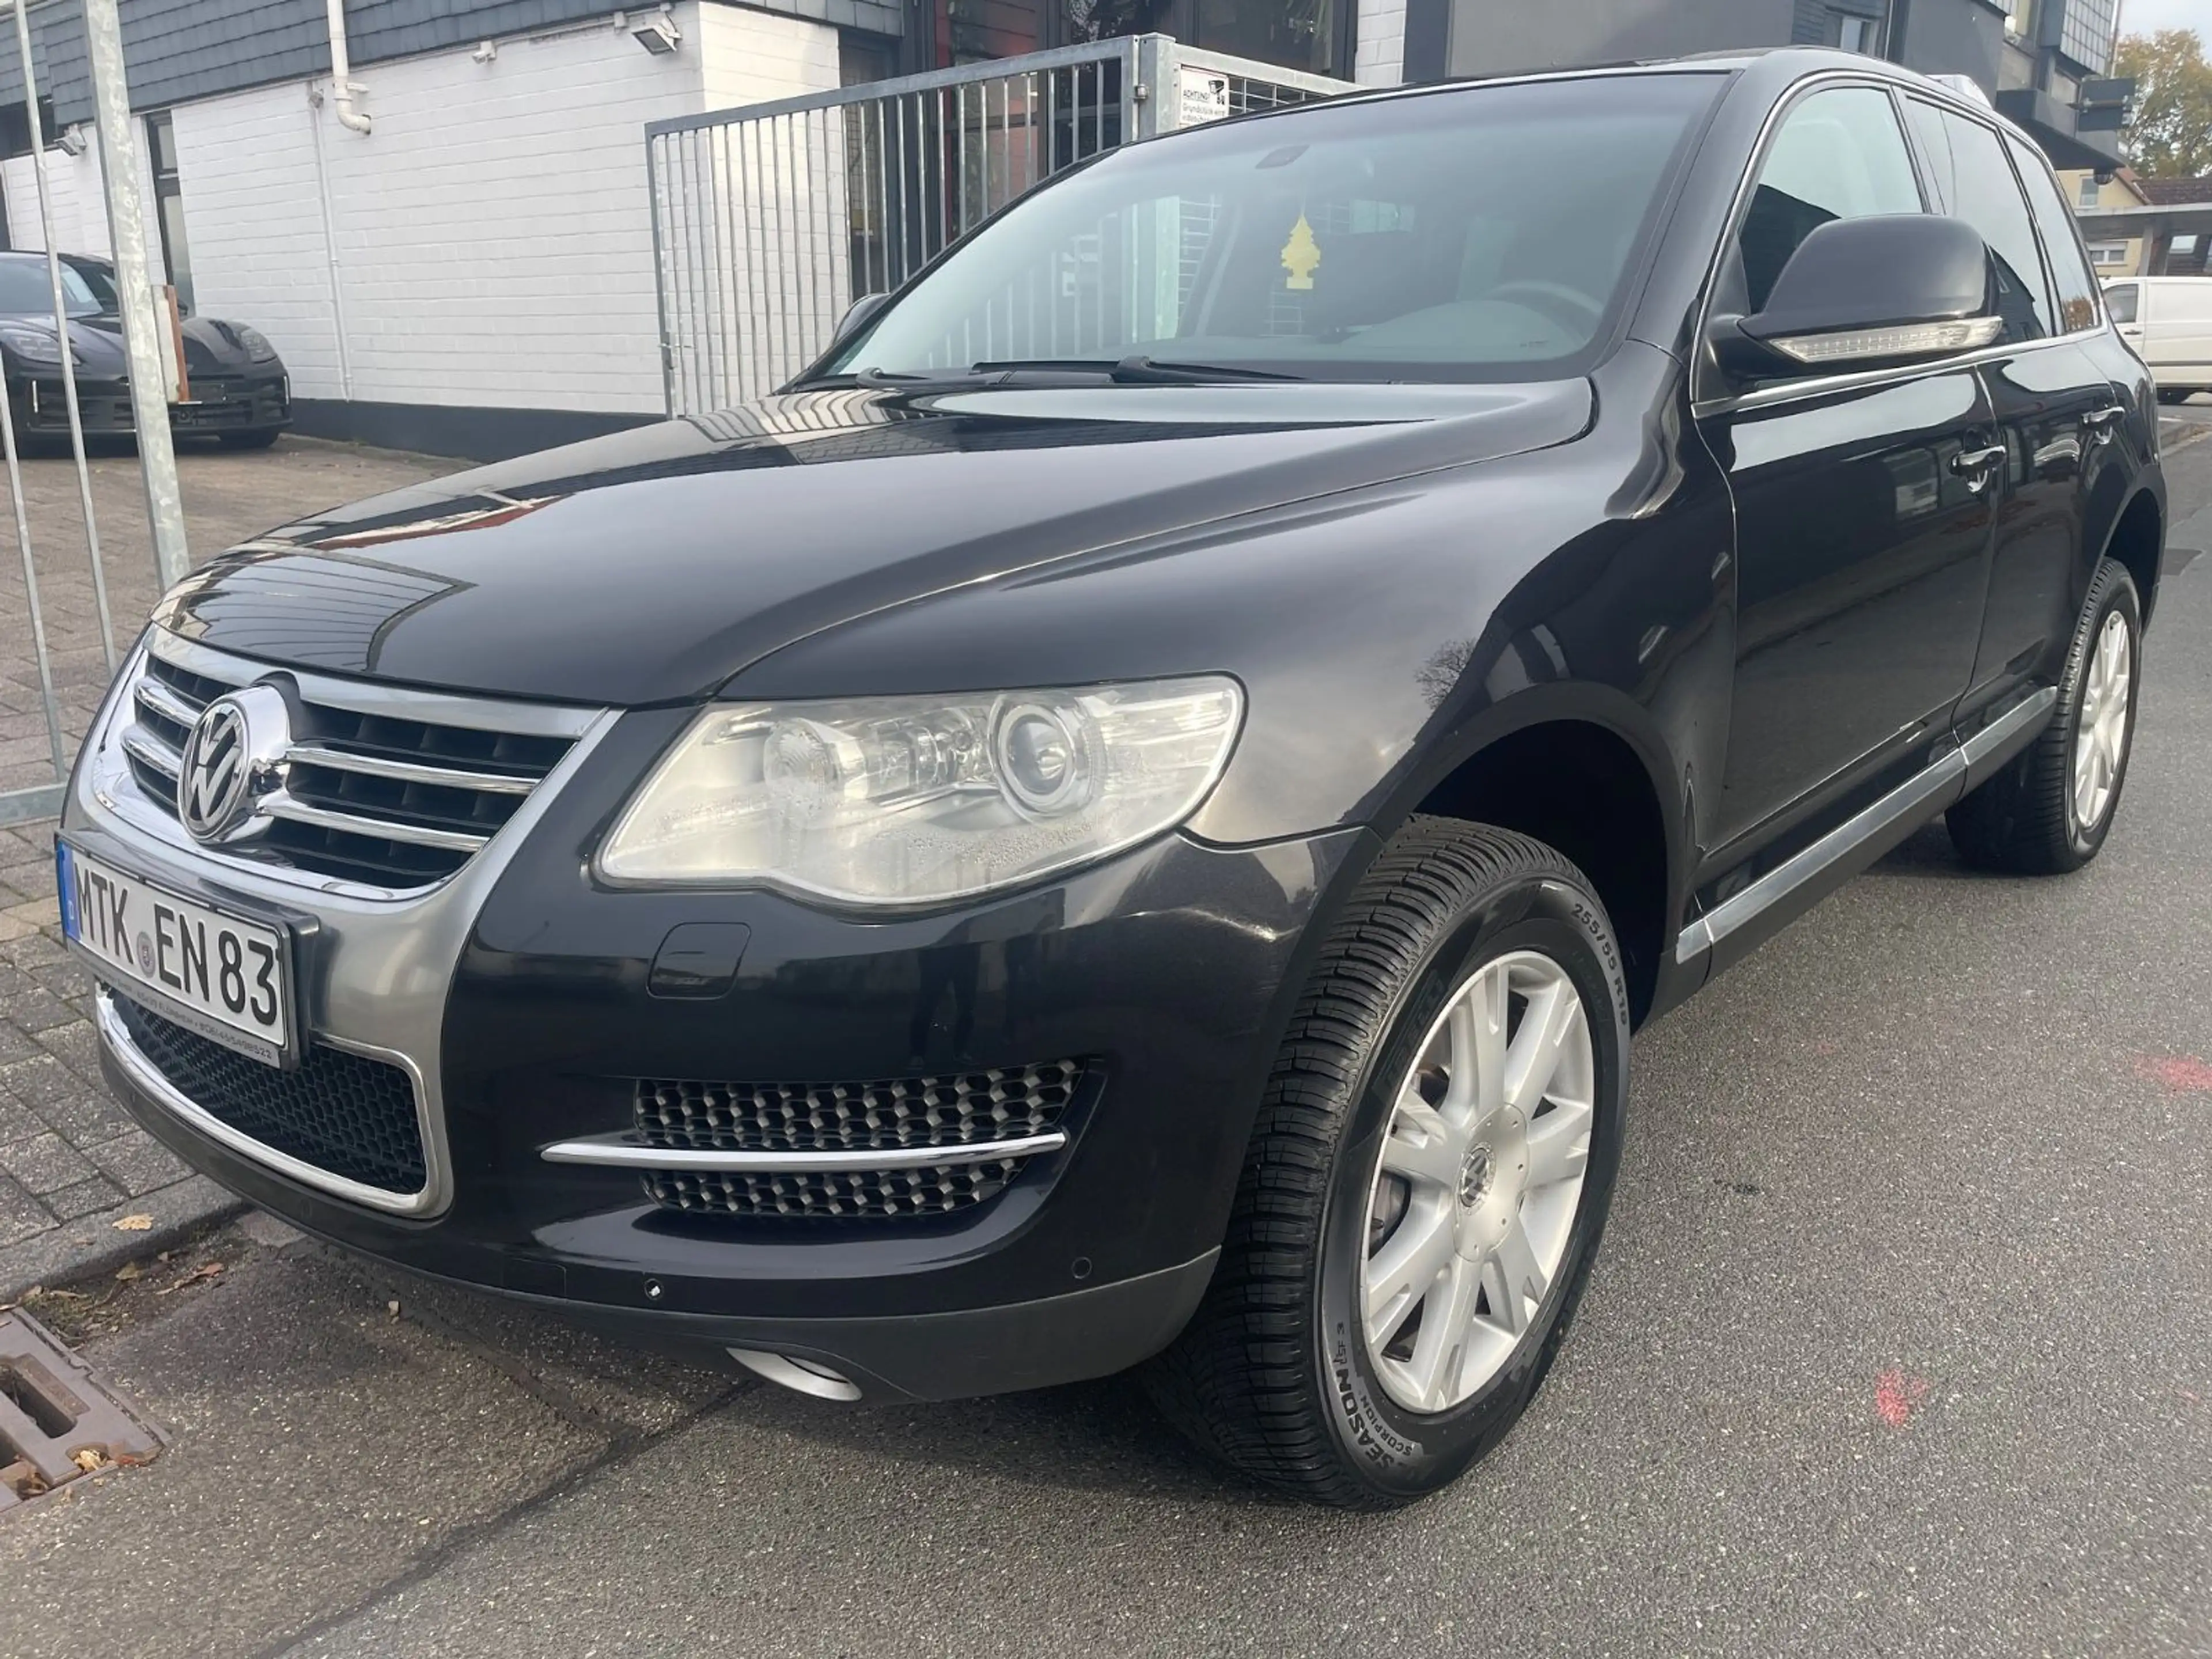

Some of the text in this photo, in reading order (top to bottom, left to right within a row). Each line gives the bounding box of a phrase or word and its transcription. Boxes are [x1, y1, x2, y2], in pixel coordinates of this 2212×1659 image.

[74, 862, 134, 964] MTK
[154, 903, 210, 1003] EN
[218, 930, 278, 1027] 83
[1571, 903, 1618, 971] 255/55
[1336, 1368, 1395, 1468] SEASON
[1360, 1394, 1413, 1456] SCORPION
